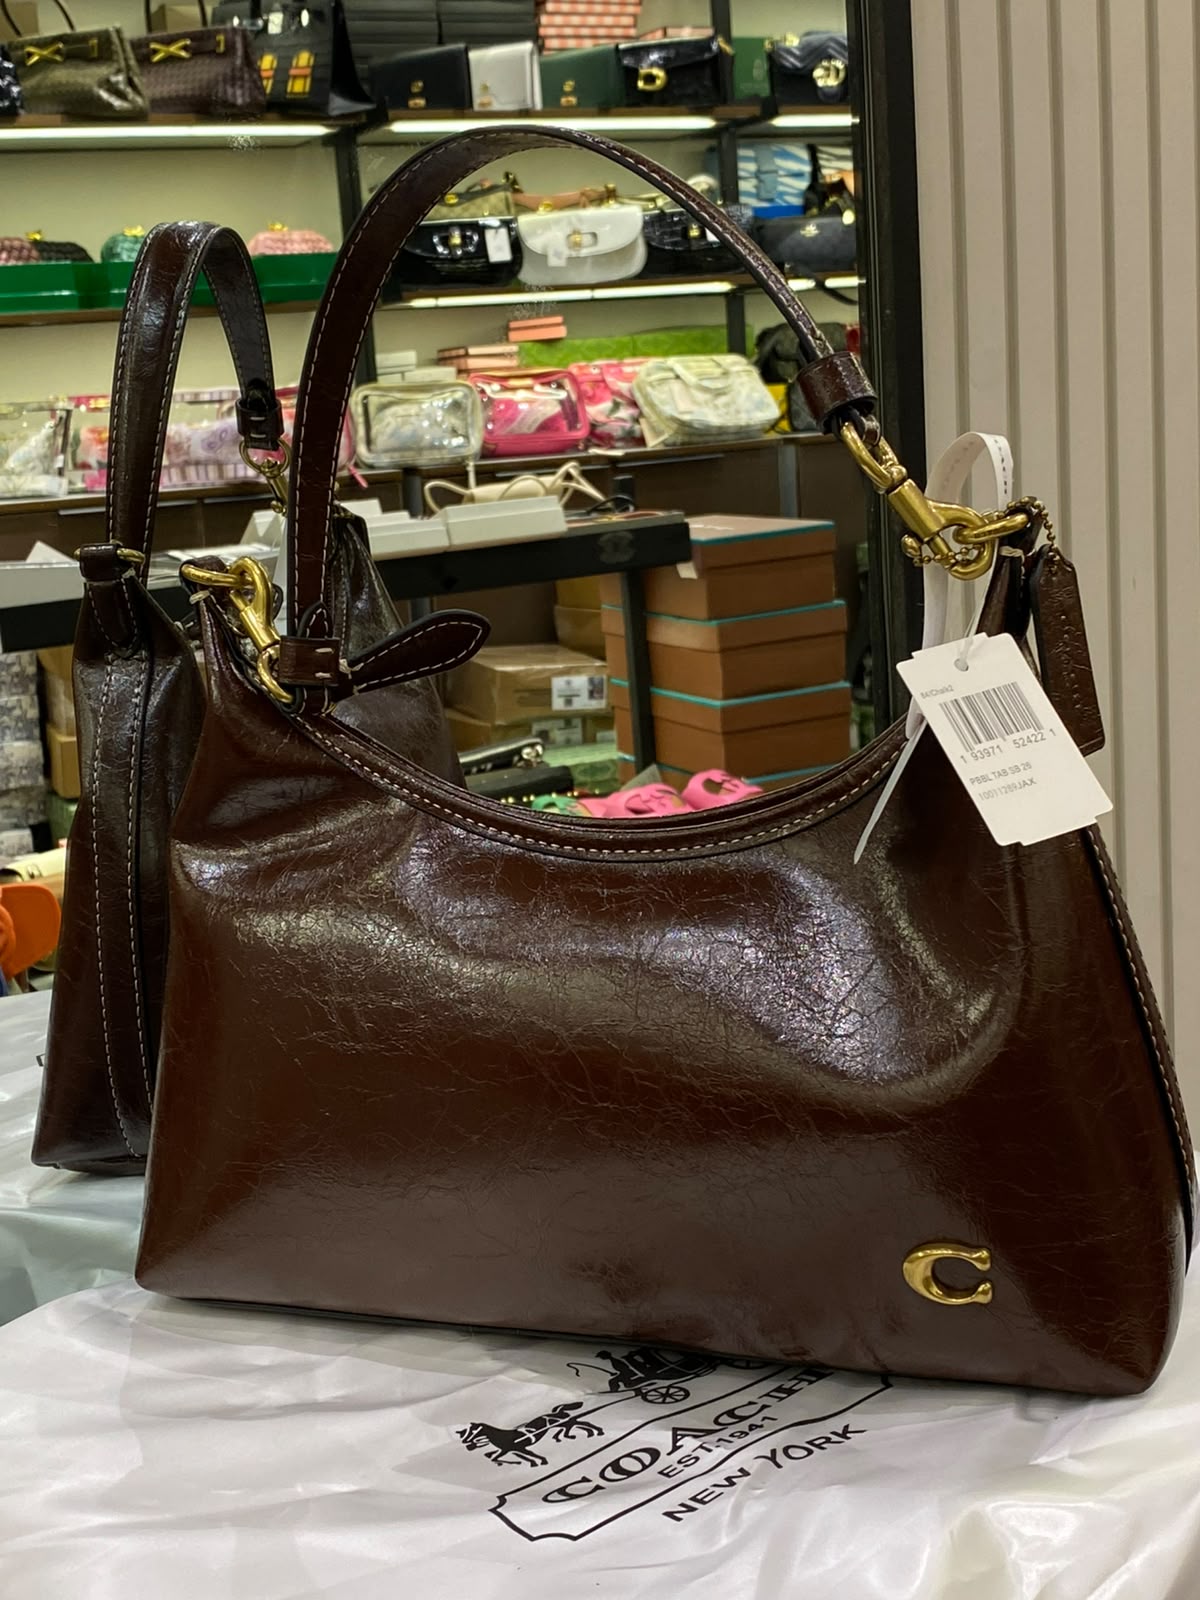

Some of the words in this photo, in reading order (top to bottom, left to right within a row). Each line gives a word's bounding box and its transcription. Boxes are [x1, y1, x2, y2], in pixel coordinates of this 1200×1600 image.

[960, 754, 968, 764] 1
[970, 744, 1004, 761] 93971
[1012, 732, 1047, 749] 52422
[1049, 728, 1057, 737] 1
[969, 774, 993, 785] PBBL
[992, 768, 1009, 779] TAB
[902, 1242, 992, 1306] C
[541, 1365, 835, 1504] COACH
[662, 1466, 752, 1522] NEW
[753, 1423, 868, 1469] YORK
